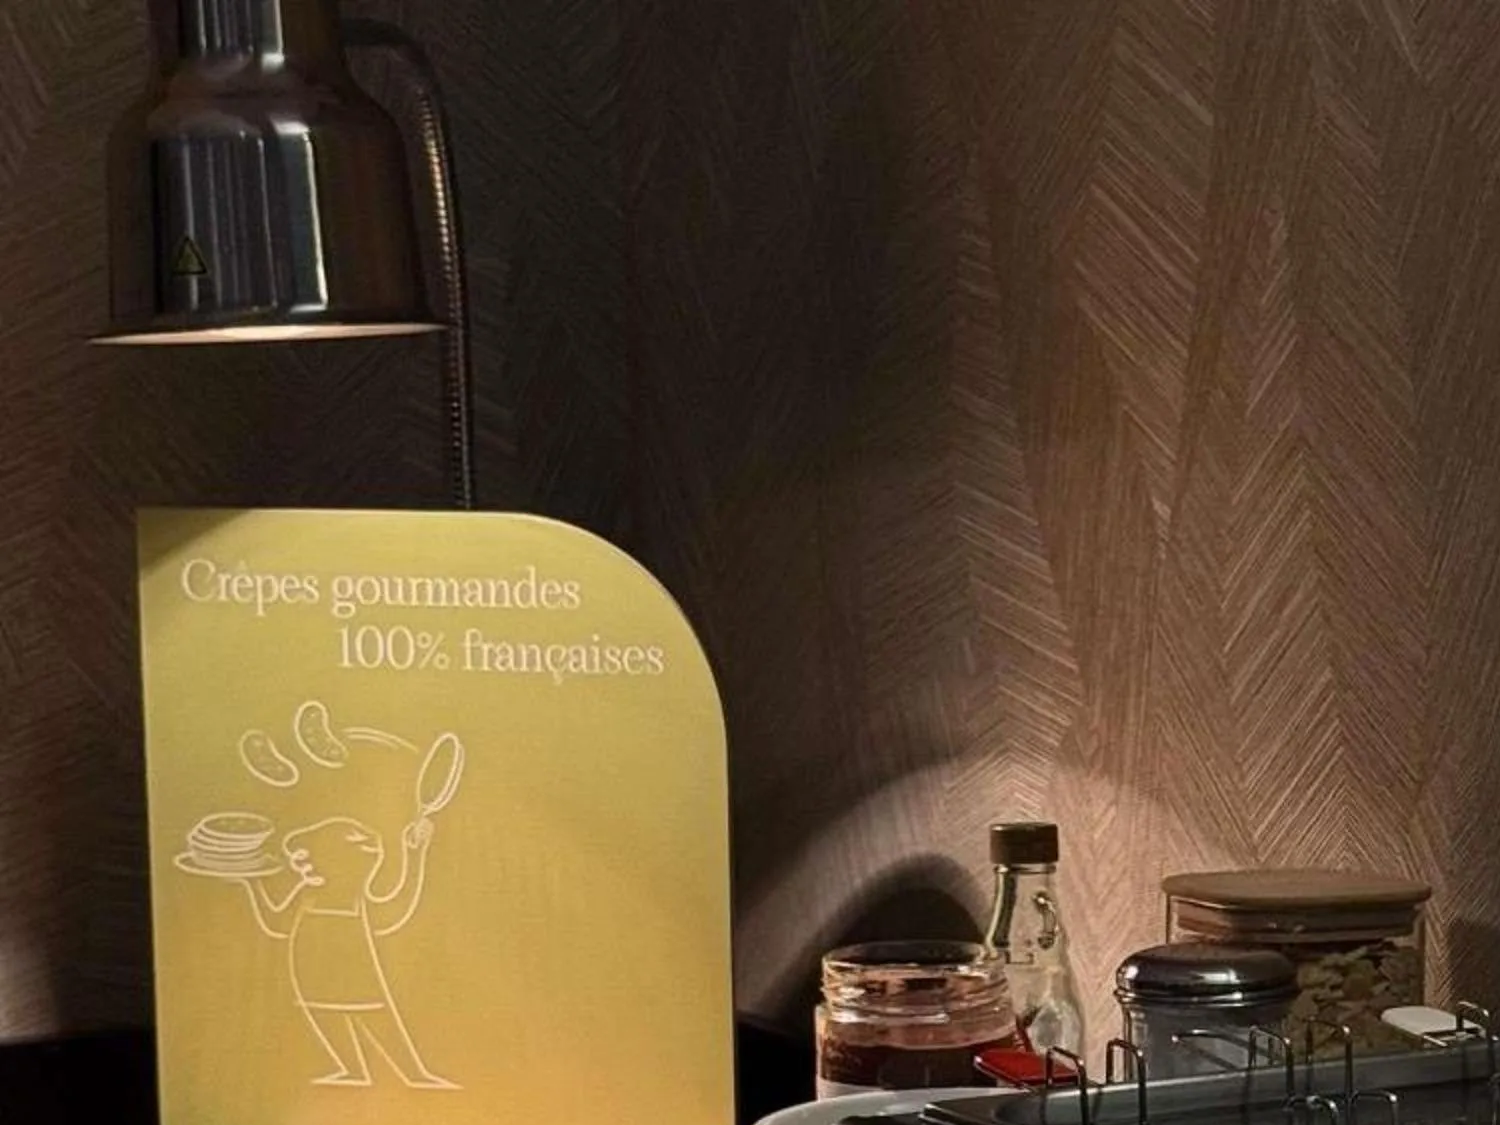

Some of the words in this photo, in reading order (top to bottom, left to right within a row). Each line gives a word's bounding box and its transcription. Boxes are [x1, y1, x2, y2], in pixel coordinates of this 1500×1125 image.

[181, 559, 320, 617] Crêpes
[330, 565, 581, 619] gourmandes
[338, 625, 450, 672] 100%
[462, 628, 665, 685] françaises
